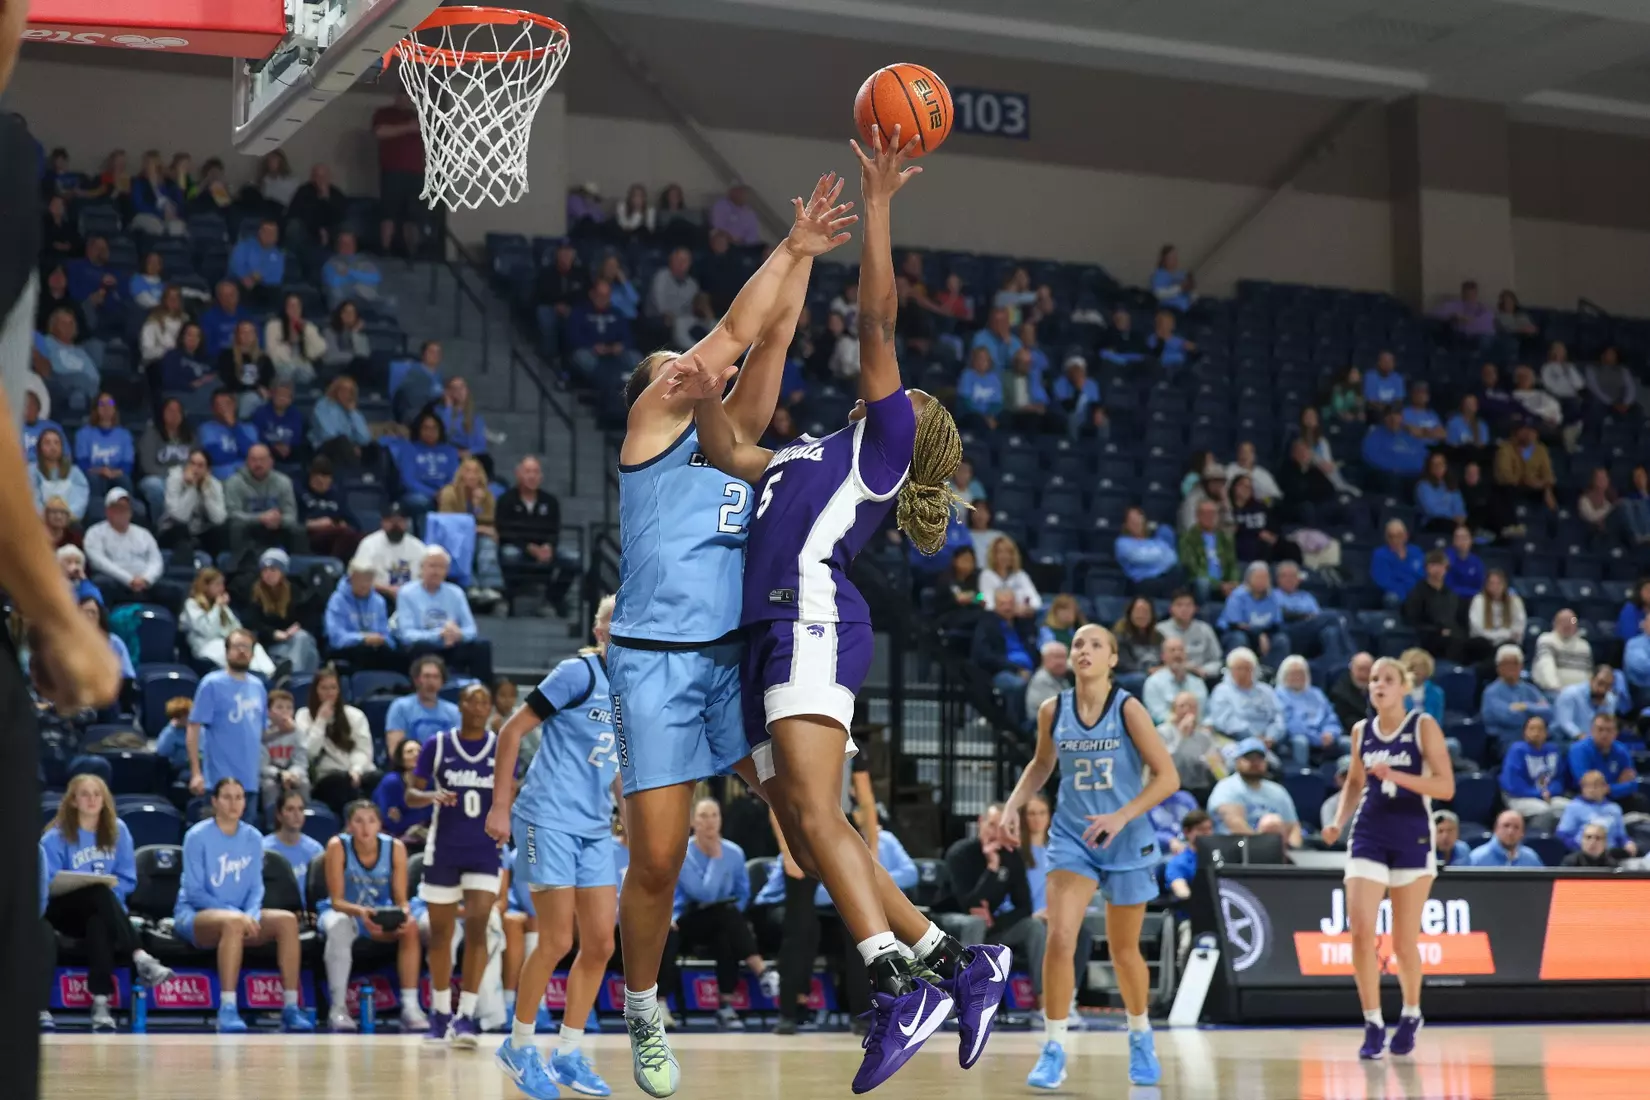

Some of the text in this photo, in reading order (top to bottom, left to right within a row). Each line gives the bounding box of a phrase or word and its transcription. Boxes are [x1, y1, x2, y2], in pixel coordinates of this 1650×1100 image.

[914, 78, 942, 130] ELITE
[957, 92, 1026, 134] 103
[717, 482, 748, 535] 2
[756, 470, 784, 520] 5
[1059, 738, 1121, 752] CREIGHTON
[1074, 757, 1113, 791] 23
[464, 790, 481, 818] 0
[210, 852, 253, 887] Jays
[1320, 888, 1470, 936] Jnen
[1319, 942, 1353, 965] TIR
[68, 979, 89, 993] IDE
[160, 979, 200, 994] IDEAL
[252, 979, 285, 995] IDEA
